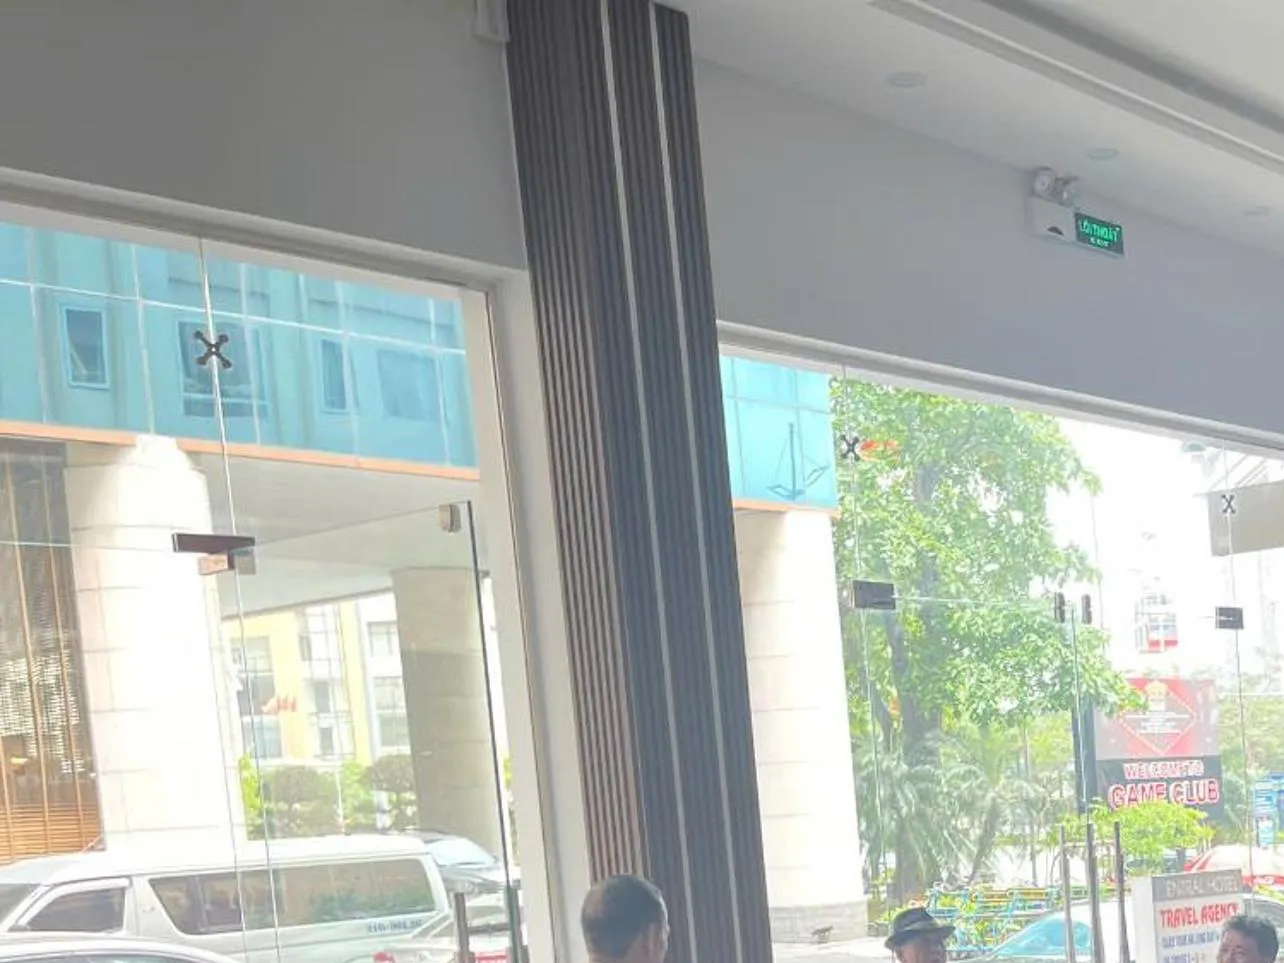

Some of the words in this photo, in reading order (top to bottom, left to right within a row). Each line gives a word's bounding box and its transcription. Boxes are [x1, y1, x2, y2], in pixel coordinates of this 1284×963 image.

[1109, 782, 1166, 809] GAME
[1169, 779, 1220, 805] CLUB
[1160, 907, 1199, 928] TRAVEL
[1201, 902, 1238, 925] AGENCY
